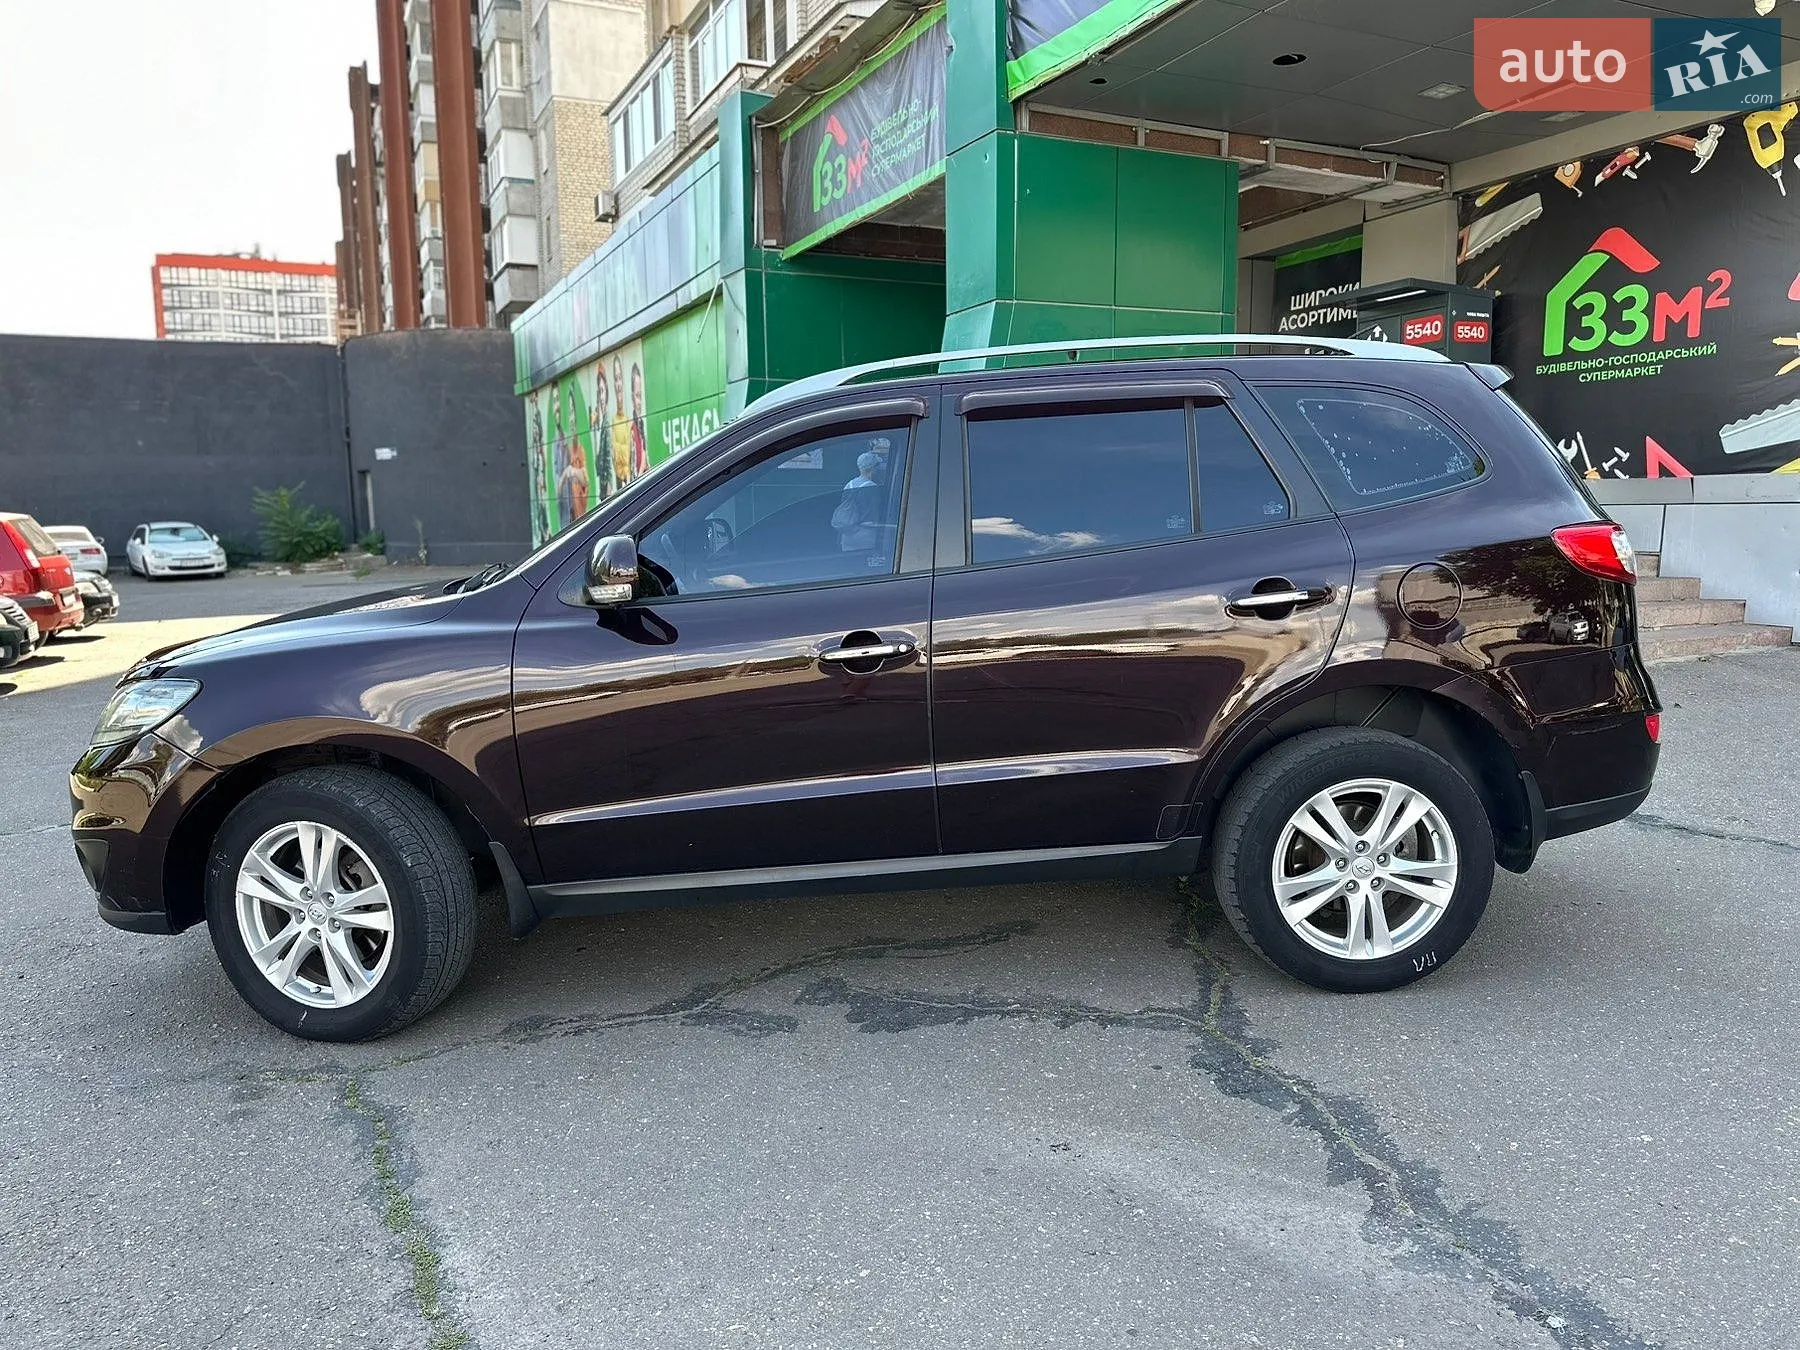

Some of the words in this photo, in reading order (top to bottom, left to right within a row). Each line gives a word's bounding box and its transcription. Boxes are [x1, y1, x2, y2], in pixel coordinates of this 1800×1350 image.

[1405, 320, 1442, 340] 5540
[1457, 325, 1485, 339] 5540
[1535, 342, 1718, 375] БУДІВЕЛЬНО-ГОСПОДАРСЬКИЙ
[1578, 364, 1664, 383] СУПЕРМАРКЕТ
